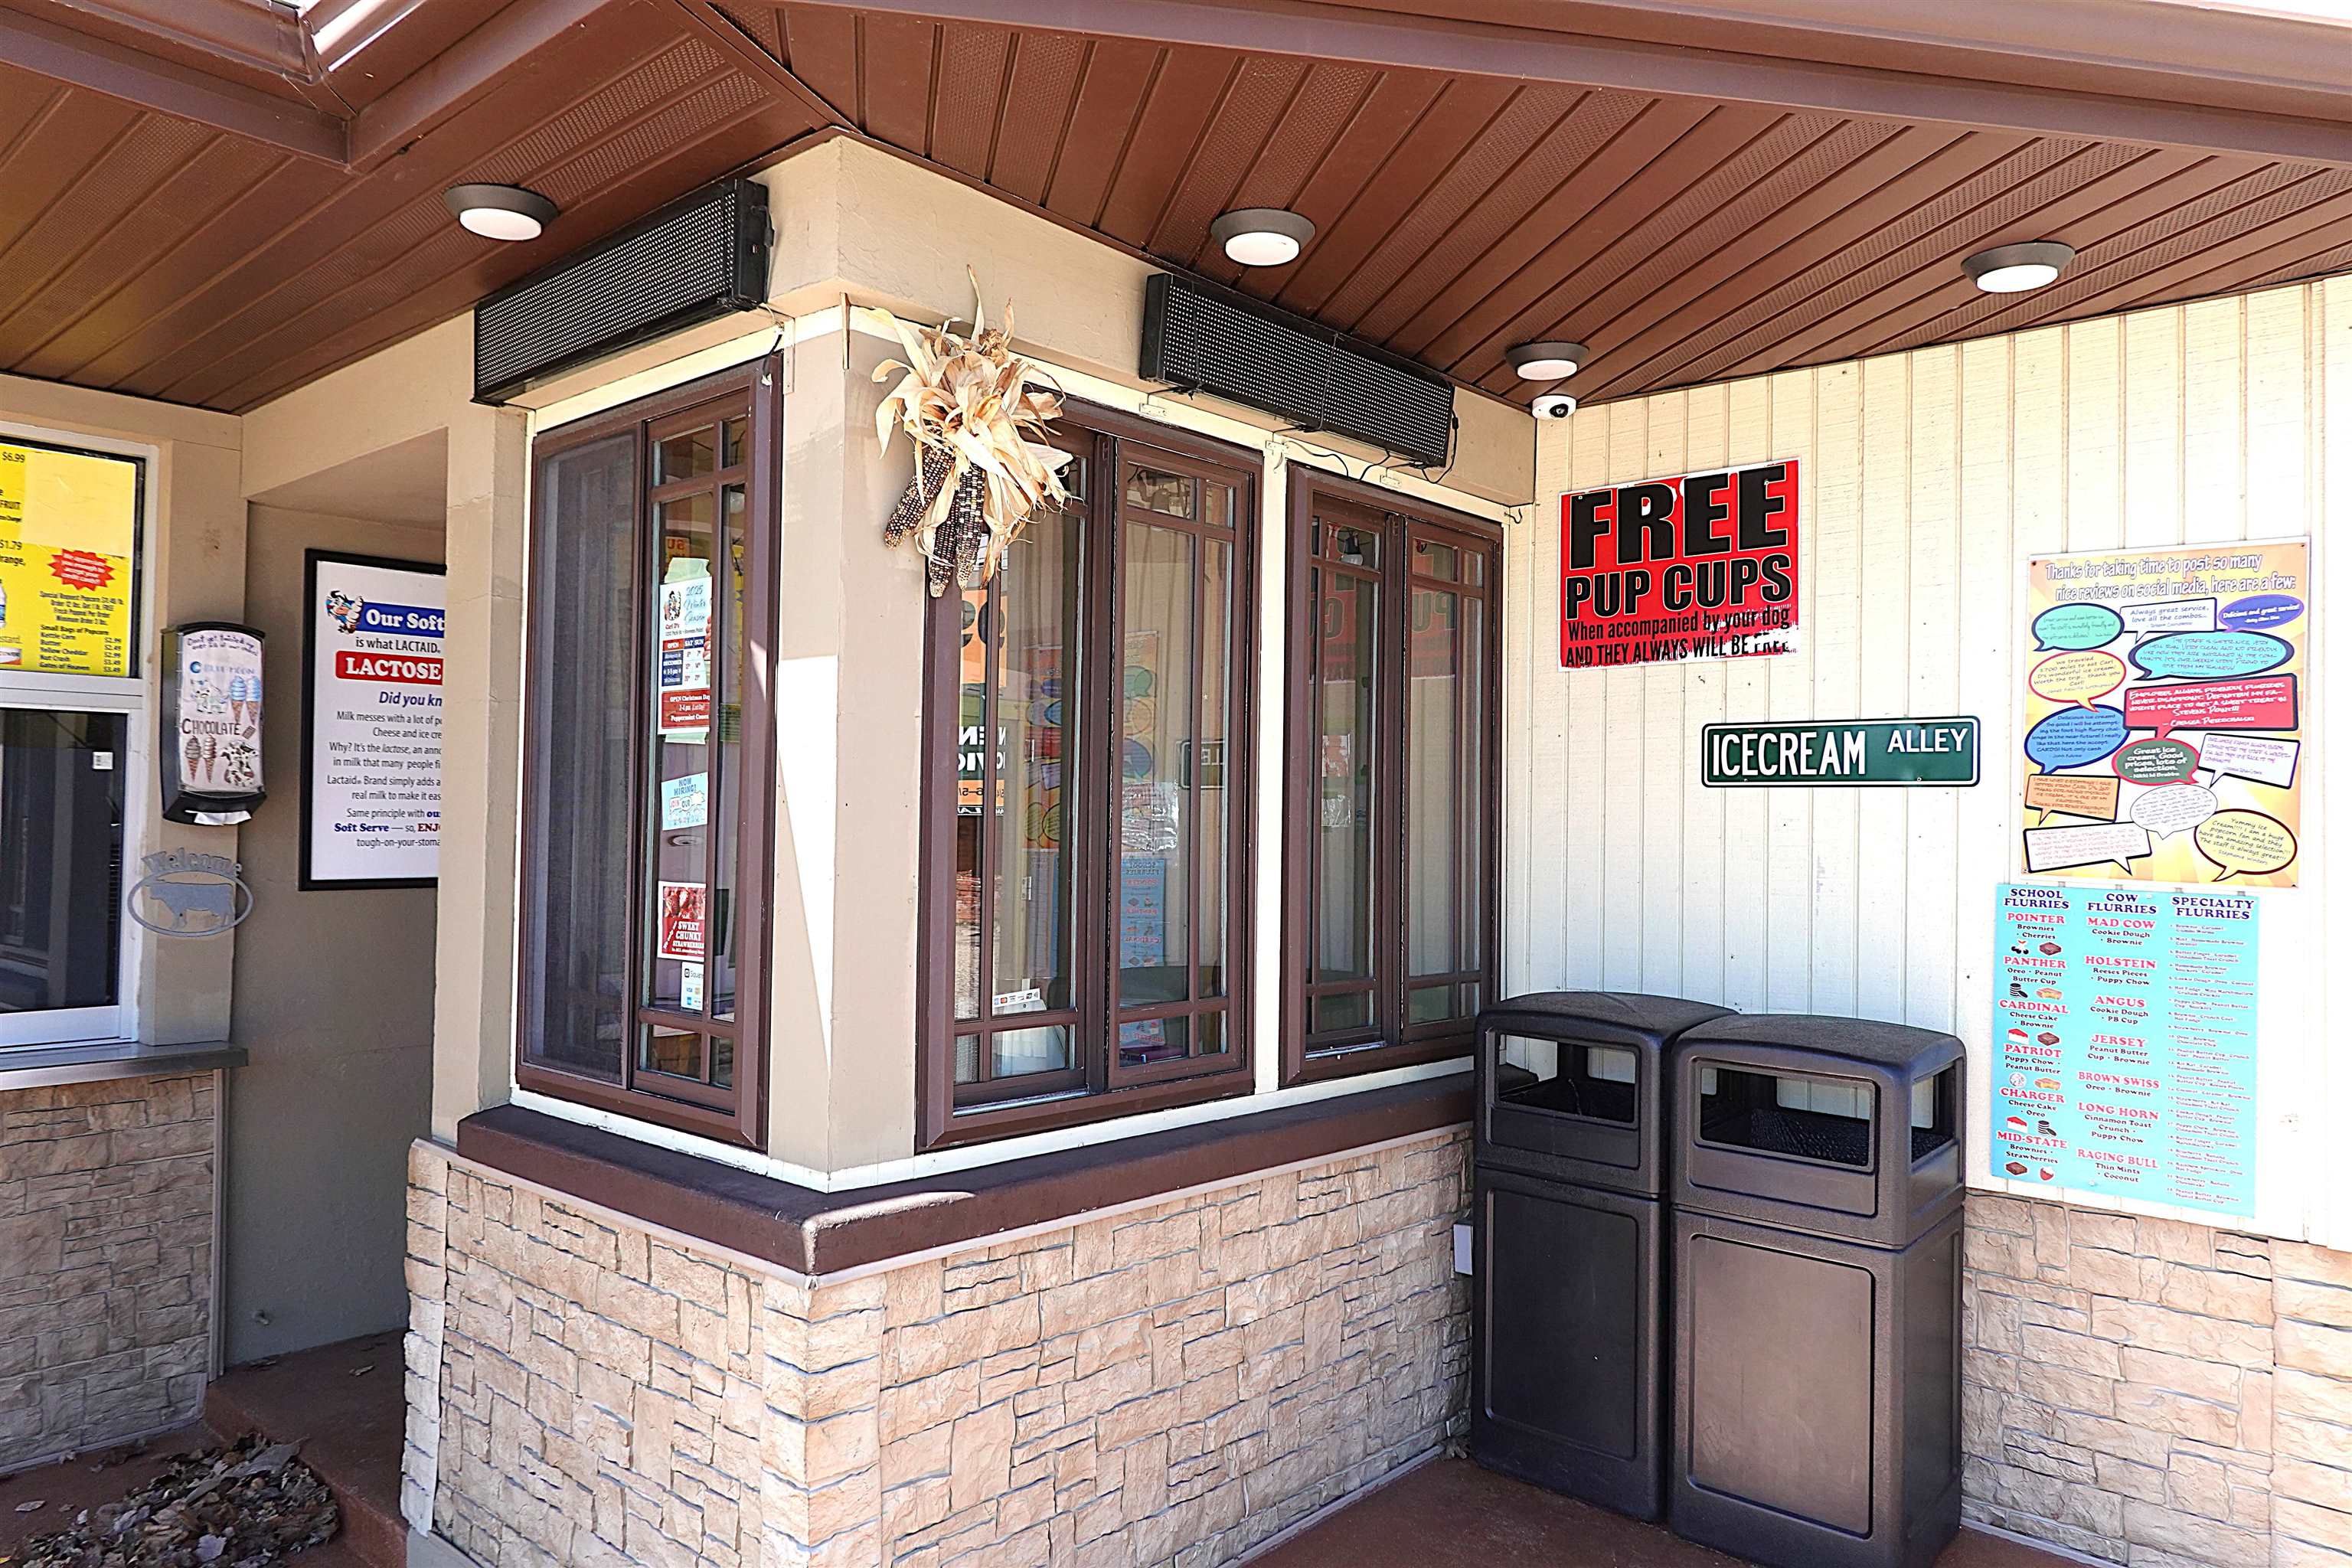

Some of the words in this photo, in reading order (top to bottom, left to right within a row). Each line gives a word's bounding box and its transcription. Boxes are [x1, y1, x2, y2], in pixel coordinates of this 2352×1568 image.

[2, 452, 25, 462] $6.99
[1570, 463, 1788, 570] FREE
[2046, 562, 2082, 580] Thanks
[2084, 560, 2101, 577] for
[2102, 558, 2138, 580] taking
[2139, 557, 2165, 574] time
[2167, 557, 2181, 573] to
[2183, 555, 2212, 578] post
[2213, 557, 2227, 570] so
[2230, 554, 2262, 572] many
[1566, 570, 1651, 621] PUP
[1663, 553, 1792, 612] CUPS
[2056, 584, 2077, 601] nice
[2078, 583, 2119, 600] reviews
[2121, 583, 2135, 598] on
[2137, 578, 2169, 596] social
[2171, 577, 2209, 596] media,
[2211, 575, 2238, 593] here
[2239, 578, 2259, 592] are
[2260, 578, 2268, 590] a
[2269, 571, 2296, 590] few:
[366, 609, 403, 627] Our
[407, 613, 445, 631] Soft
[1569, 620, 1604, 642] When
[1608, 612, 1698, 639] accompanied
[1702, 610, 1720, 635] by
[1725, 612, 1756, 634] your
[1762, 604, 1790, 630] dog
[356, 637, 364, 648] is
[366, 639, 393, 649] what
[1566, 647, 1593, 668] AND
[1597, 642, 1629, 665] THEY
[1632, 639, 1688, 662] ALWAYS
[1693, 636, 1726, 658] WILL
[1732, 635, 1748, 655] BE
[345, 657, 442, 680] LACTOSE
[379, 691, 400, 704] Did
[402, 695, 424, 707] you
[337, 711, 354, 720] Milk
[356, 714, 385, 722] messes
[387, 714, 406, 723] with
[413, 715, 424, 724] lot
[426, 716, 434, 724] of
[181, 718, 241, 735] CHOCOLATE
[373, 727, 400, 737] Cheese
[403, 729, 417, 737] and
[419, 730, 430, 739] ice
[329, 742, 352, 753] Why?
[354, 743, 366, 753] It's
[368, 743, 381, 753] the
[1713, 730, 1866, 776] ICECREAM
[1887, 727, 1968, 753] ALLEY
[333, 757, 341, 766] in
[343, 757, 361, 766] milk
[364, 759, 380, 767] that
[382, 760, 403, 769] many
[407, 760, 433, 770] people
[364, 776, 387, 786] Brand
[389, 777, 415, 787] simply
[416, 777, 435, 786] adds
[347, 808, 369, 818] Same
[371, 808, 406, 819] principle
[407, 809, 425, 818] with
[334, 823, 358, 832] Soft
[360, 823, 389, 832] Serve
[2011, 889, 2063, 898] SCHOOL
[2106, 893, 2138, 902] COW
[2004, 898, 2069, 909] FLURRIES
[2088, 903, 2156, 913] FLURRIES
[2172, 897, 2254, 909] SPECIALTY
[2007, 913, 2064, 923] POINTER
[2177, 908, 2249, 919] FLURRIES
[2089, 918, 2118, 926] MAD
[2123, 920, 2155, 929] COW
[2004, 956, 2066, 969] PANTHER
[2086, 956, 2156, 969] HOLSTEIN
[1999, 1000, 2069, 1014] CARDINAL
[2095, 996, 2145, 1008] ANGUS
[2121, 1009, 2148, 1018] Dough
[2092, 1035, 2146, 1047] JERSEY
[2006, 1044, 2061, 1057] PATRIOT
[2089, 1046, 2118, 1054] Peanut
[2121, 1048, 2148, 1057] Butter
[2005, 1055, 2029, 1063] Puppy
[2114, 1056, 2150, 1065] Brownie
[2034, 1066, 2060, 1074] Butter
[2079, 1072, 2121, 1083] BROWN
[2124, 1076, 2160, 1089] SWISS
[2001, 1088, 2065, 1102] CHARGER
[2115, 1087, 2151, 1096] Brownie
[2078, 1102, 2114, 1114] LONG
[2119, 1107, 2159, 1120] HORN
[2084, 1115, 2127, 1125] Cinnamon
[2130, 1119, 2152, 1128] Toast
[2099, 1125, 2129, 1133] Crunch
[1997, 1131, 2067, 1148] MID-STATE
[2092, 1132, 2117, 1141] Puppy
[2010, 1144, 2047, 1154] Brownies
[2006, 1152, 2058, 1164] Strawberries
[2078, 1149, 2124, 1163] RAGING
[2128, 1155, 2158, 1168] BULL
[2096, 1163, 2115, 1171] Thin
[2117, 1166, 2140, 1174] Mints
[2104, 1173, 2138, 1182] Coconut
